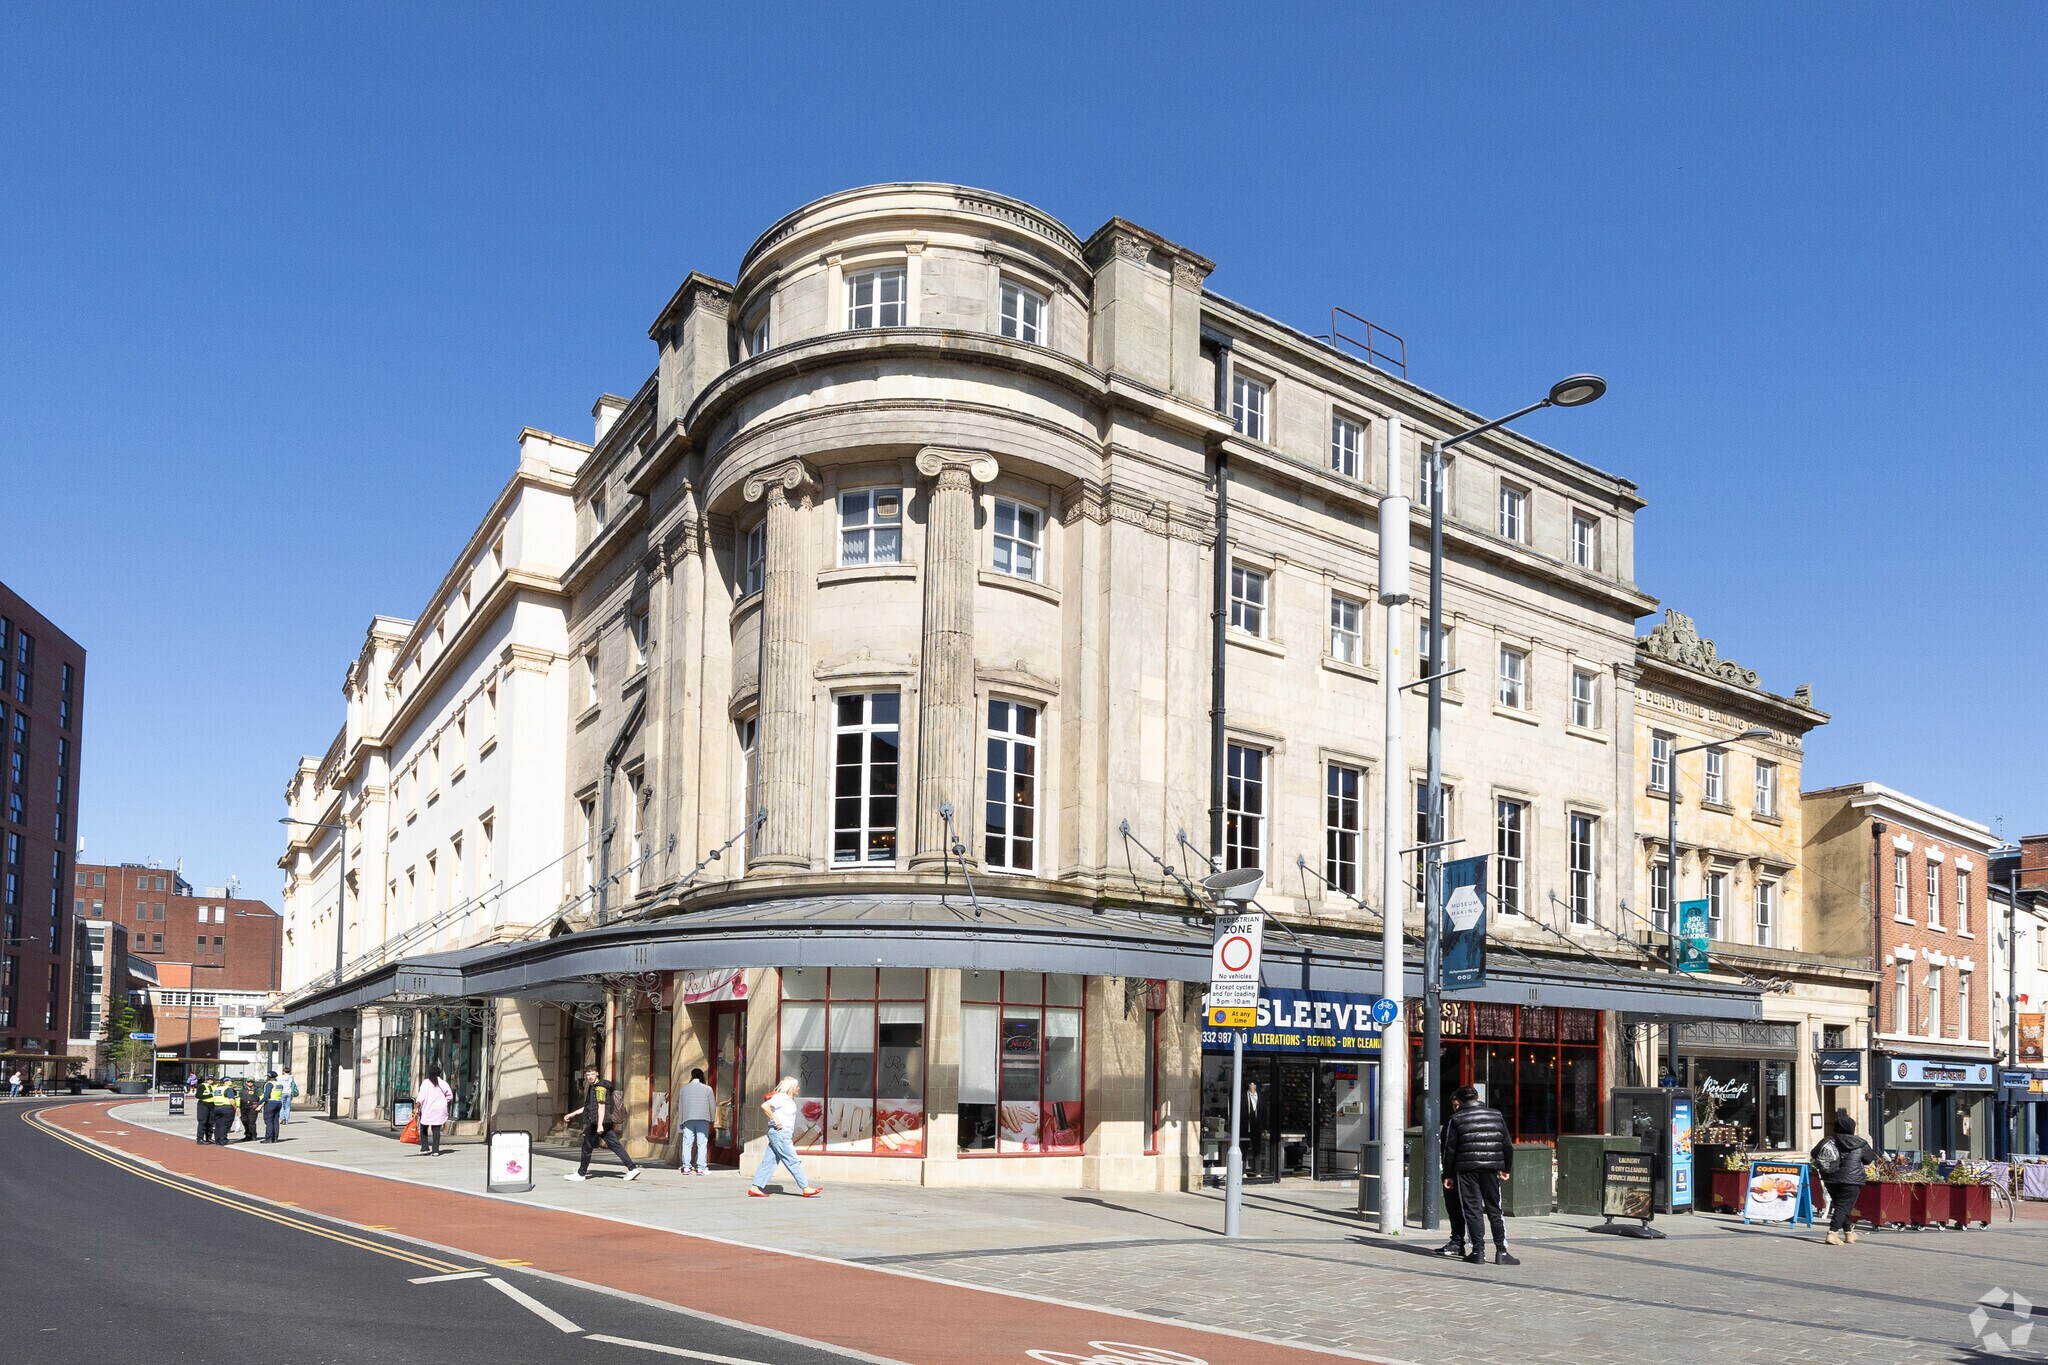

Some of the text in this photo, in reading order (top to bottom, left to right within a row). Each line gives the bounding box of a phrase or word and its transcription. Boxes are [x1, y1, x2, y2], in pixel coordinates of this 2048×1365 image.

[1646, 689, 1705, 718] DERBYSHIRE
[1708, 709, 1744, 730] BANKING
[1451, 900, 1478, 908] MUSEUM
[1451, 908, 1478, 916] MAKING
[1218, 916, 1260, 924] PEDESTRIAN
[1223, 924, 1253, 935] ZONE
[1202, 1031, 1216, 1042] 332
[1252, 1033, 1300, 1046] ALTERATIONS
[1307, 1035, 1336, 1047] REPAIRS
[1342, 1036, 1356, 1048] DRY
[1722, 1078, 1749, 1099] Café
[1625, 1166, 1648, 1174] CLEANING
